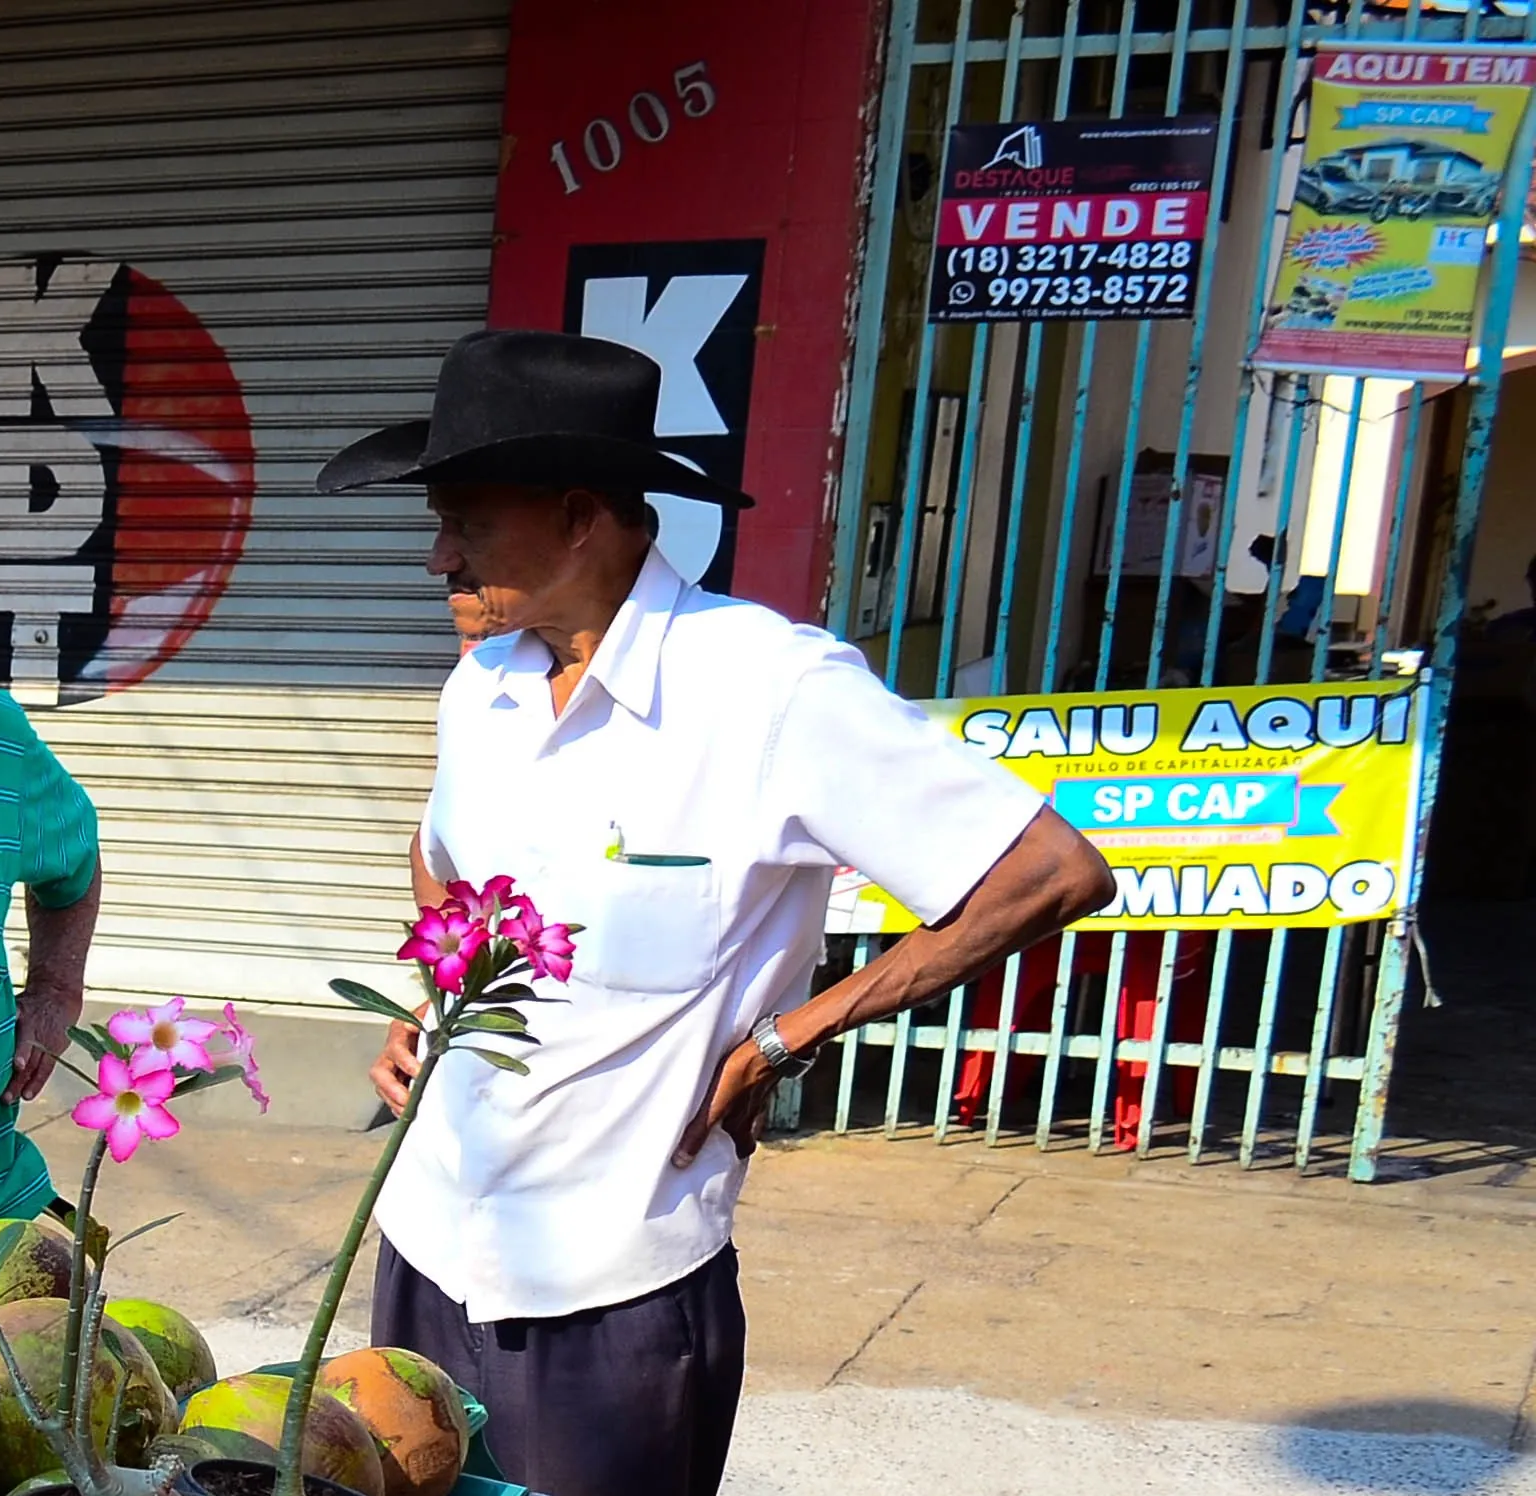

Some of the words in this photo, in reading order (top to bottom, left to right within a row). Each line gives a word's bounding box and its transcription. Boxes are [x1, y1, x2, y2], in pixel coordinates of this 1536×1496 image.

[1325, 53, 1429, 81] AQUI
[1439, 55, 1529, 83] TEM
[549, 60, 717, 195] 1005
[1375, 106, 1405, 123] SP
[1410, 107, 1457, 124] CAP
[954, 166, 1076, 190] DESTAQUE
[956, 197, 1190, 241] VENDE
[946, 245, 1010, 278] (18)
[1015, 241, 1192, 273] 3217-4828
[987, 273, 1189, 307] 99733-8572
[962, 702, 1159, 760] SAIU
[1180, 694, 1410, 752] AQUI
[1055, 761, 1120, 774] TÍTULO
[1126, 759, 1148, 772] DE
[1154, 755, 1305, 771] CAPITALIZAÇÃO
[1092, 783, 1155, 824] SP
[1166, 780, 1268, 822] CAP
[1088, 859, 1396, 919] MIADO
